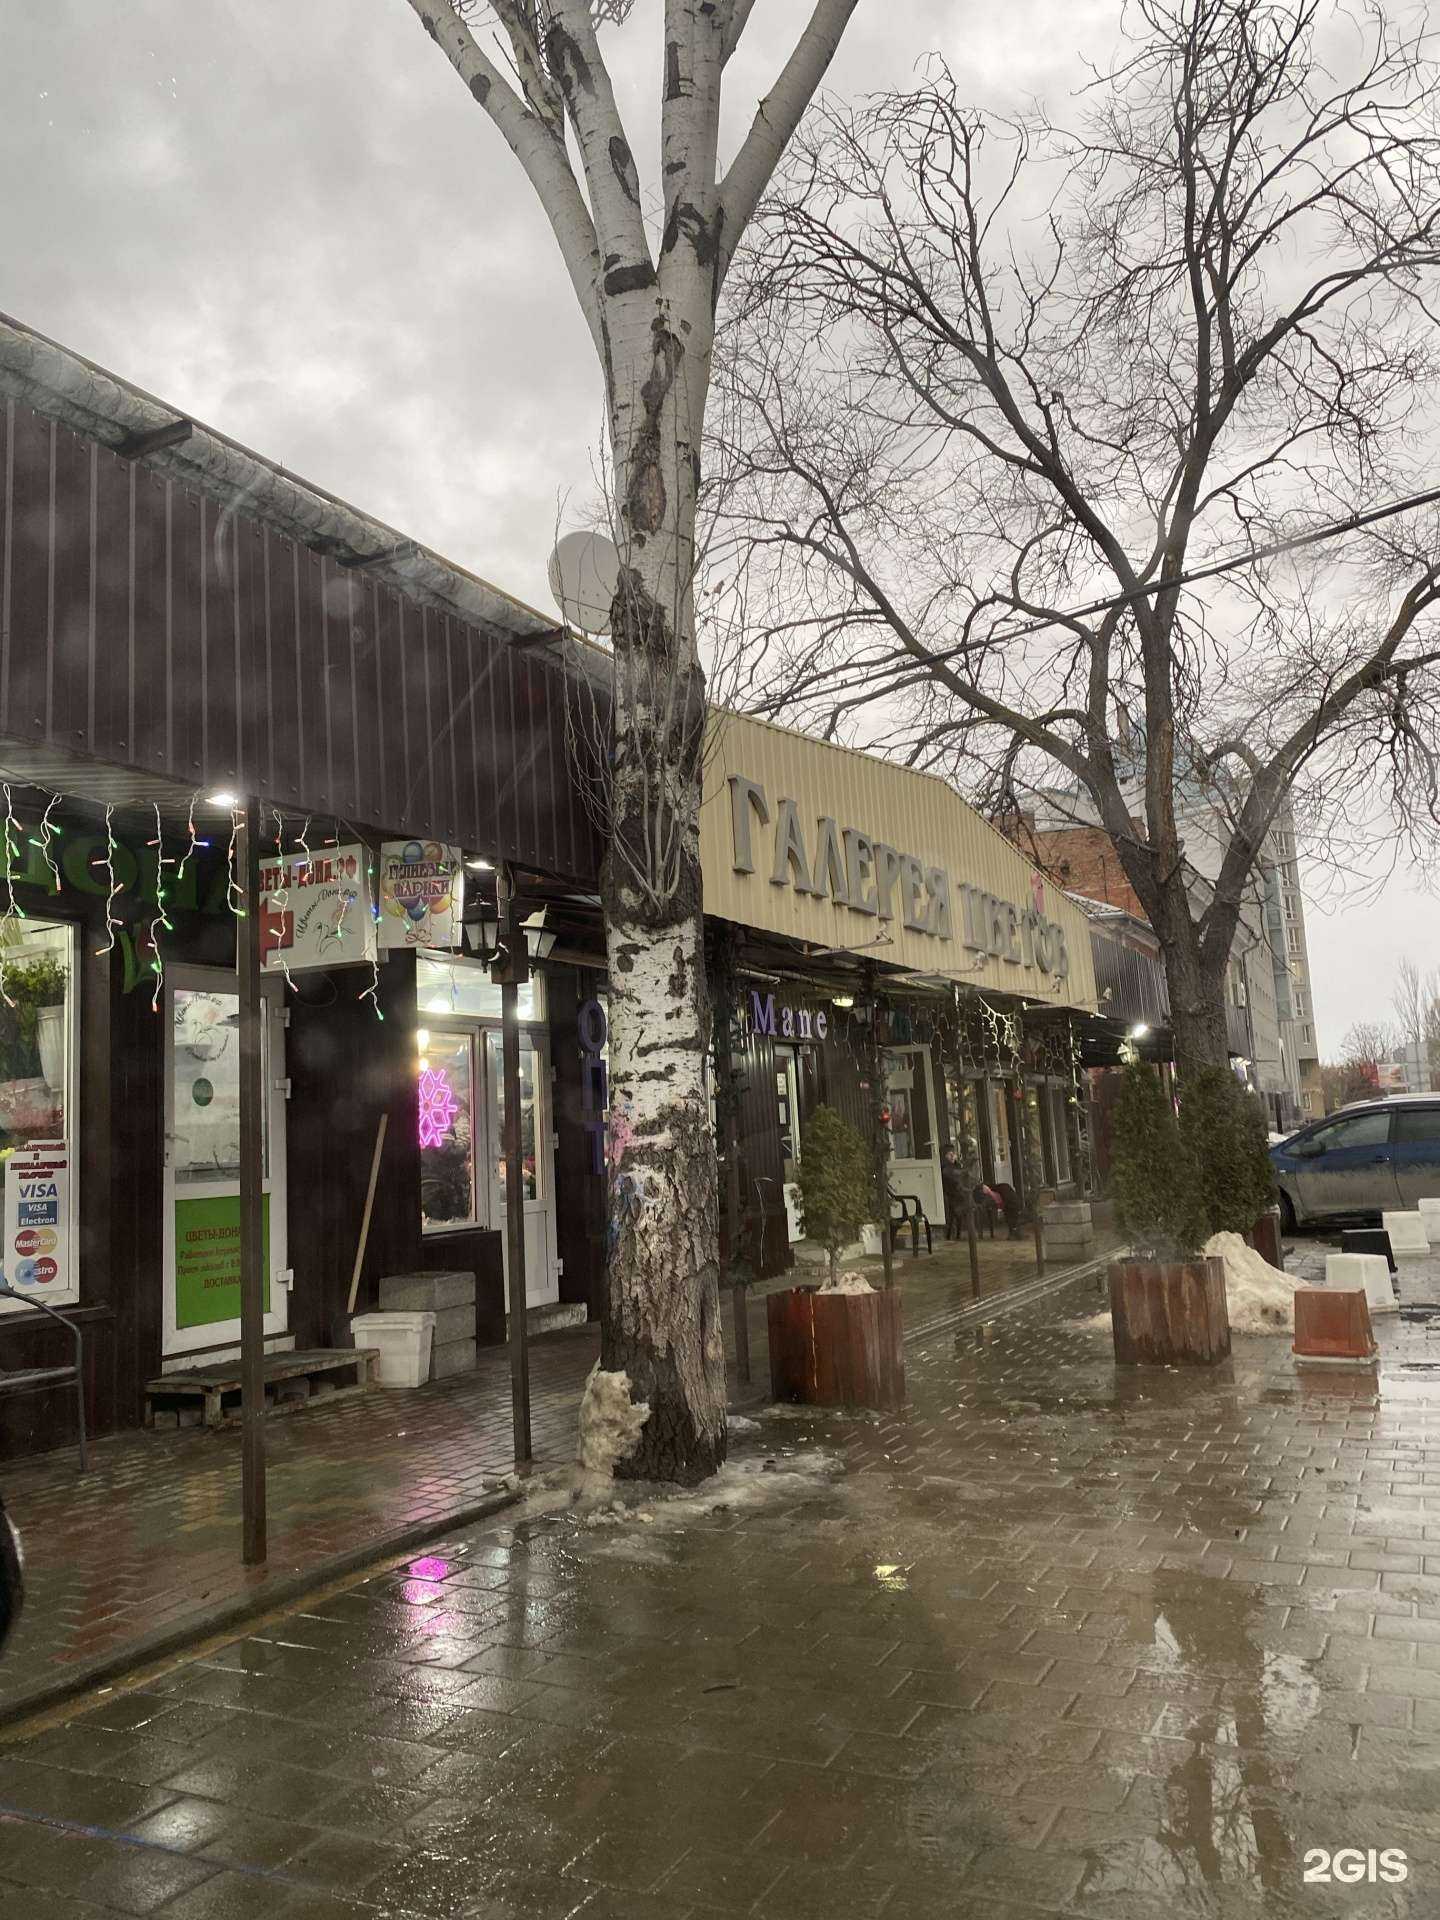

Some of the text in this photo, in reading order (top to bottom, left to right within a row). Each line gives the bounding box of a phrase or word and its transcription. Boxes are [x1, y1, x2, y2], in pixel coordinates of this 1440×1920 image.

[727, 774, 952, 941] ГАЛЕРЕЯ
[19, 1184, 57, 1198] VISA
[28, 1203, 48, 1212] VISA
[21, 1217, 55, 1225] Electron
